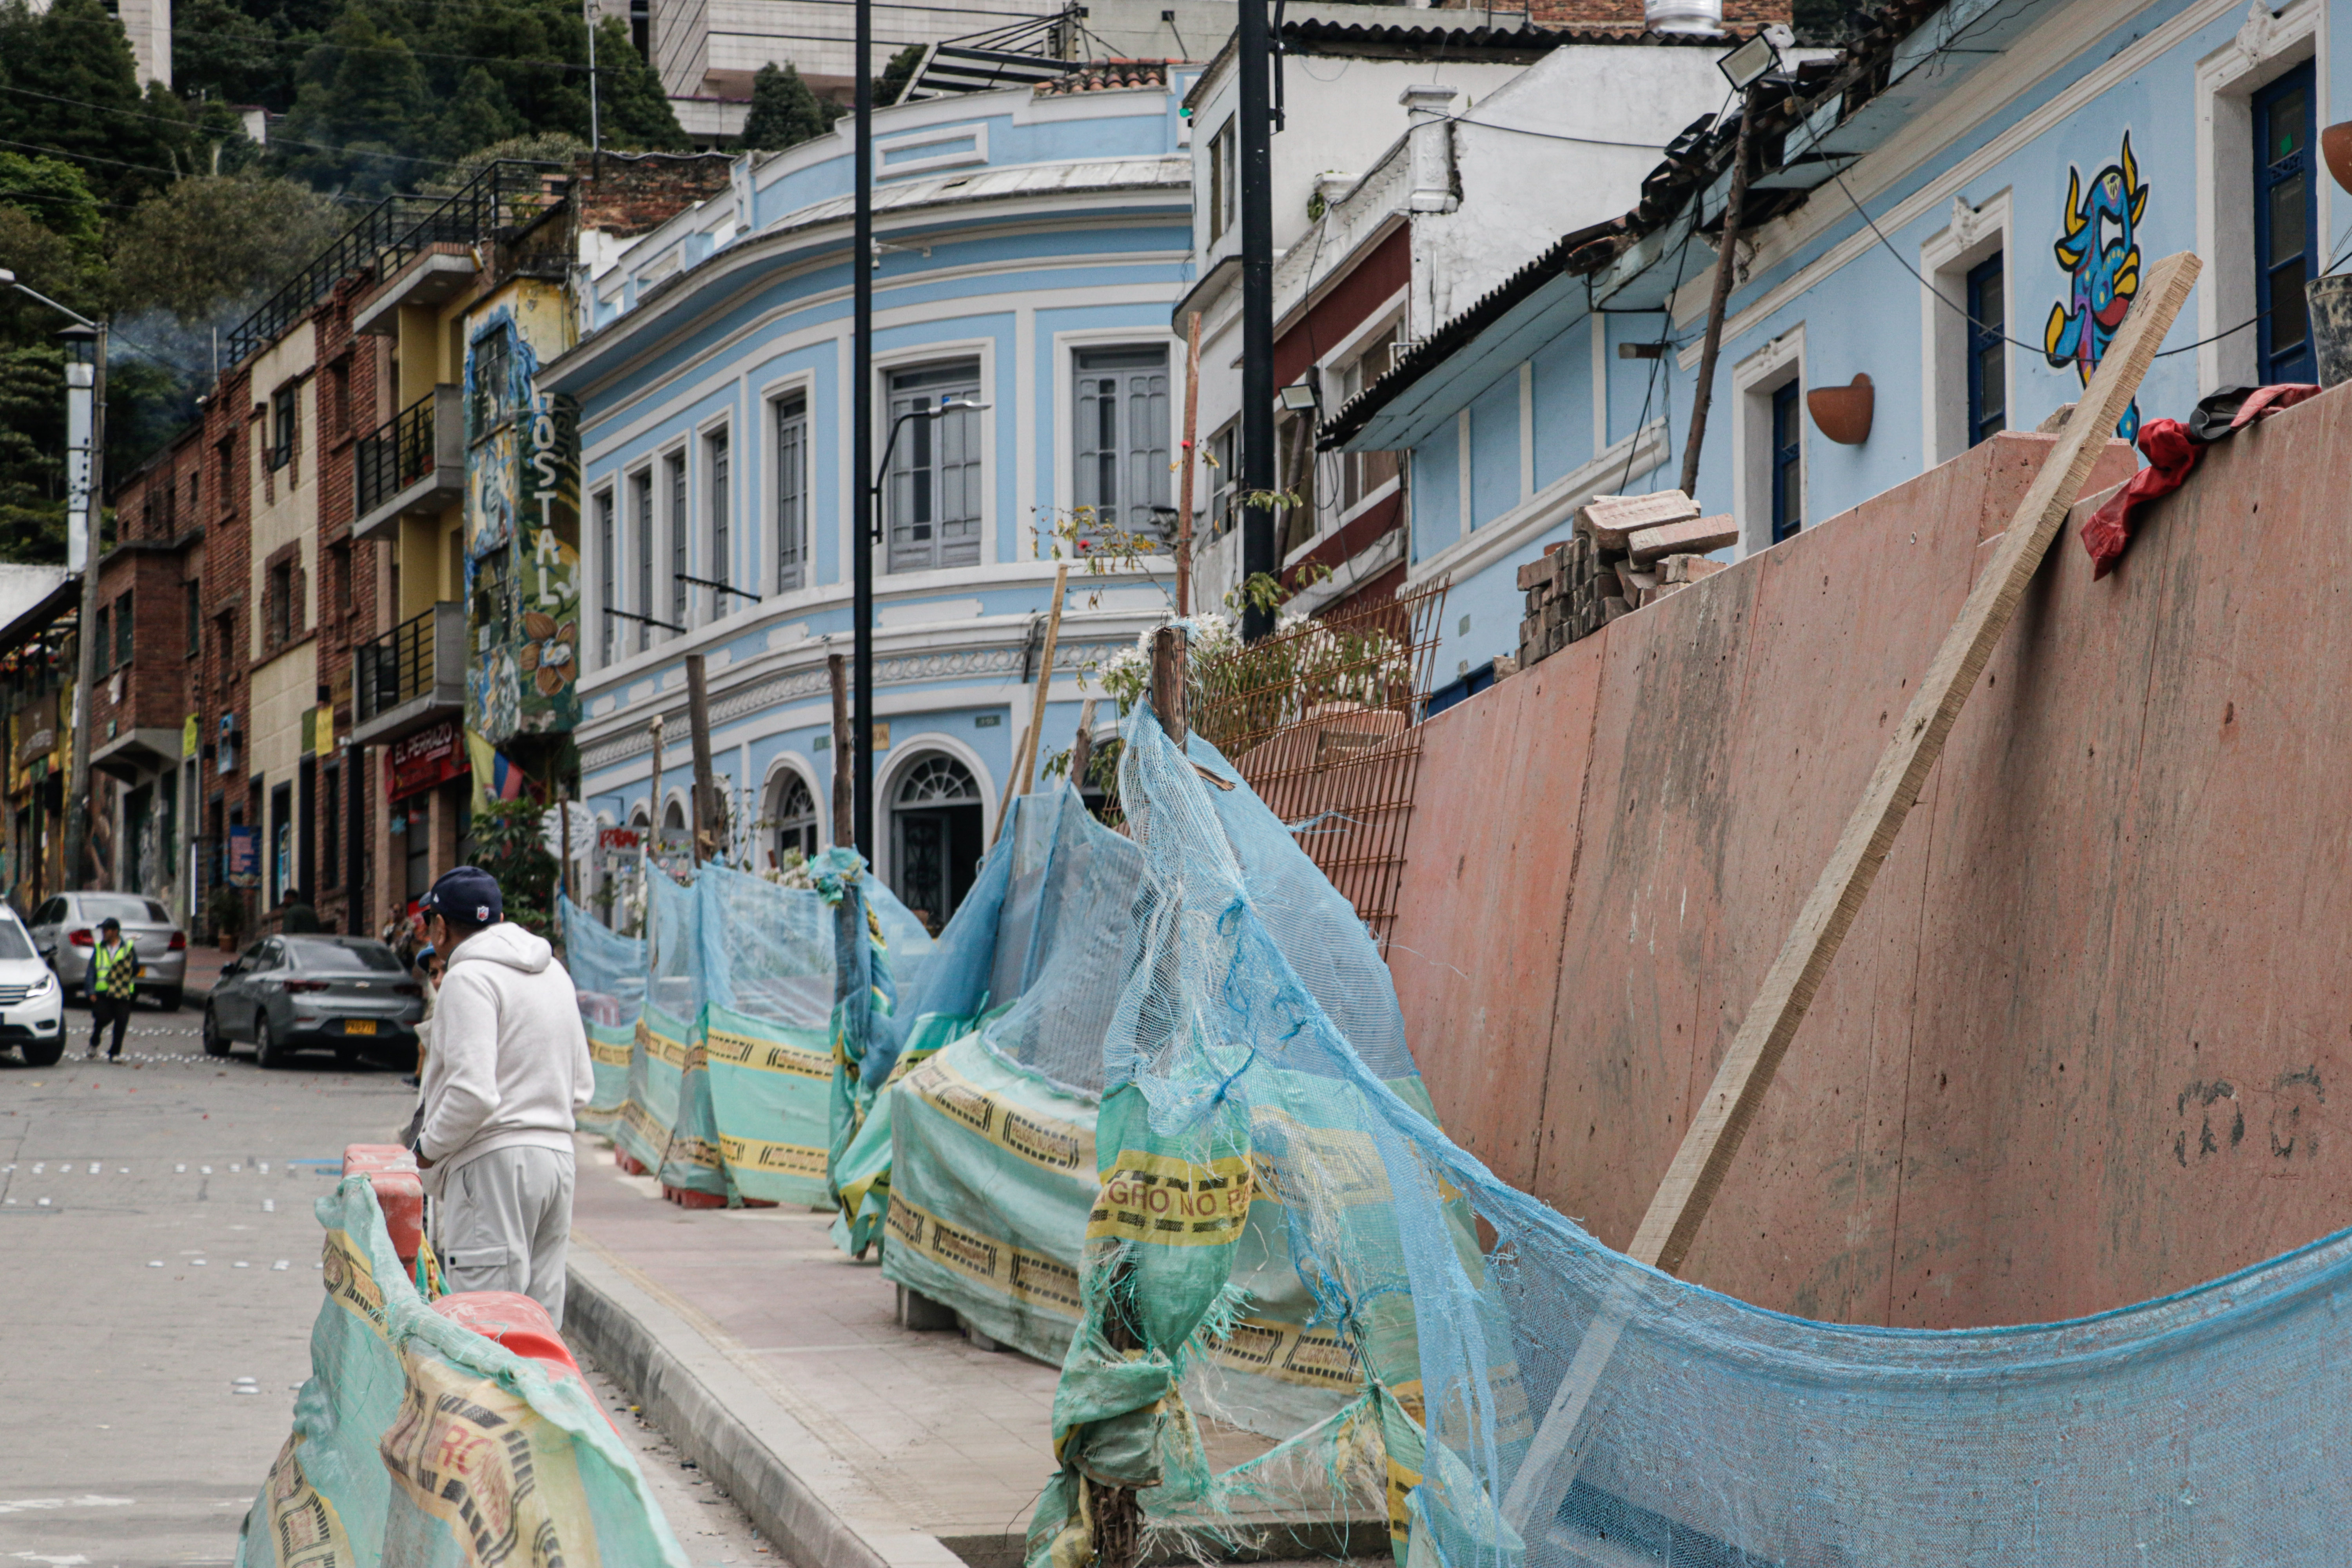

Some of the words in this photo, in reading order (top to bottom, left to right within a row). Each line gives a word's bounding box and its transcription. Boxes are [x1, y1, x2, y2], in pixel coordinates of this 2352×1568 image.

[531, 380, 560, 605] HOSTAL
[395, 742, 406, 764] EL
[1180, 1193, 1217, 1216] NO
